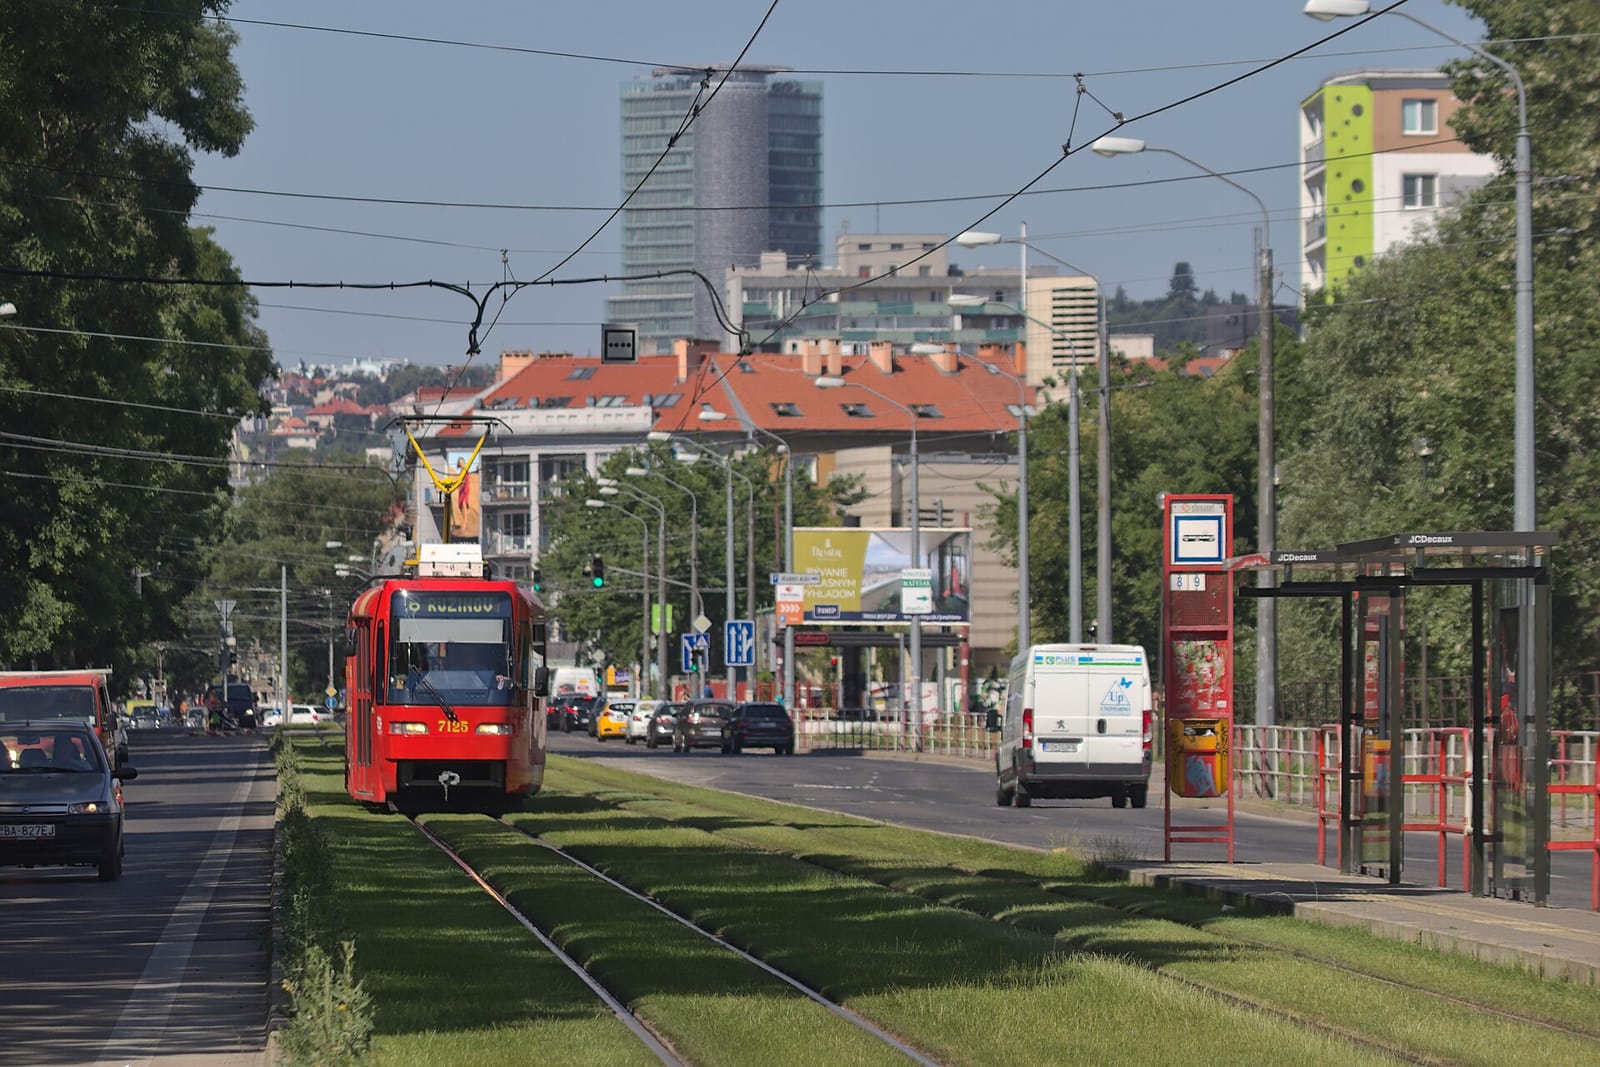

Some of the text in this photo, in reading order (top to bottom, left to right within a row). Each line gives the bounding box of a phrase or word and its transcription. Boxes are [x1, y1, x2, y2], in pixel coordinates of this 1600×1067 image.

[1408, 534, 1453, 544] JCDecaux
[1278, 553, 1318, 562] JCDecaux
[1176, 576, 1183, 587] 8
[1194, 576, 1201, 587] 9
[438, 720, 469, 733] 7125
